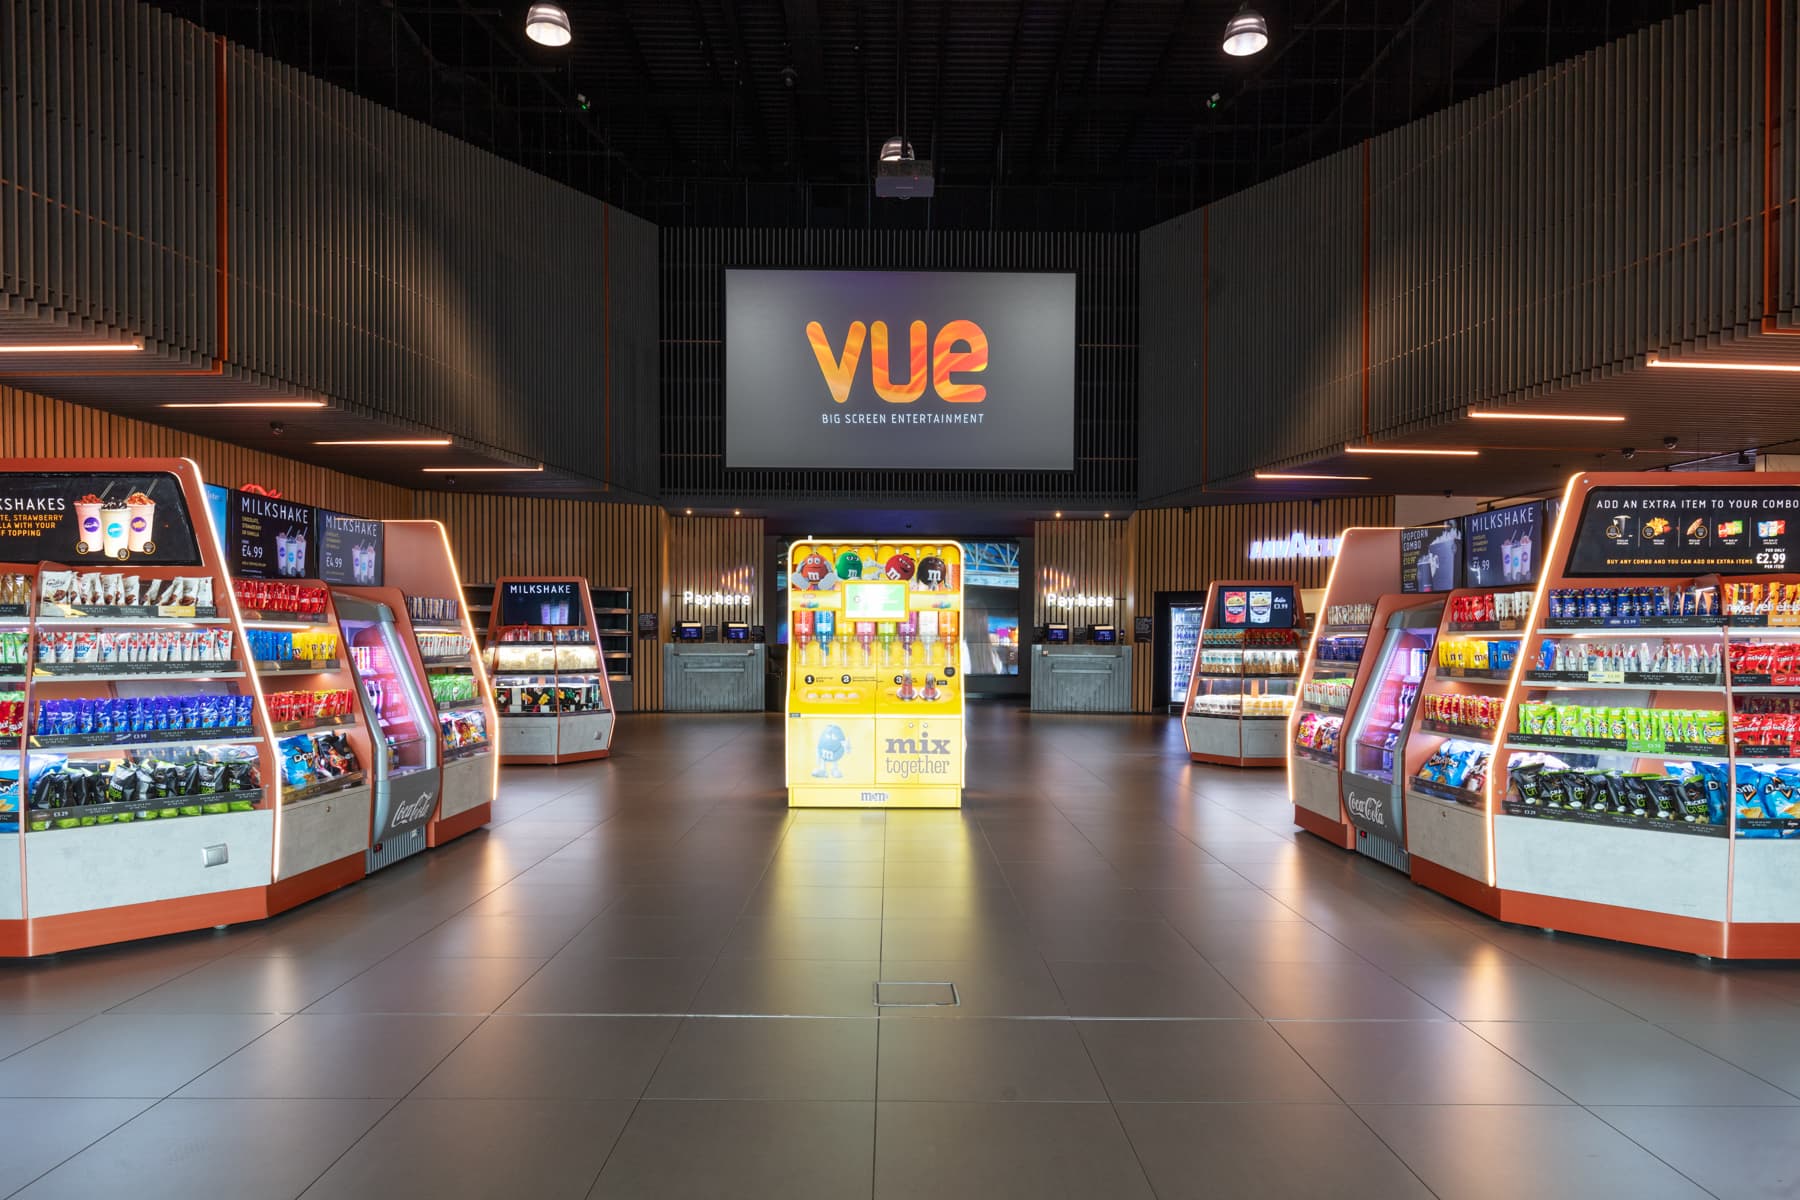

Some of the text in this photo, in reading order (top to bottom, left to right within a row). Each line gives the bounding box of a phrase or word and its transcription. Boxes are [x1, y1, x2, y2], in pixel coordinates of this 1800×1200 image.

[822, 413, 985, 424] BIG SCREEN ENTERTAINMENT
[241, 496, 309, 524] MILKSHAKE
[1596, 499, 1799, 509] ADD AN EXTRA ITEM TO YOUR COMBO
[325, 515, 377, 537] MILKSHAKE
[1471, 507, 1534, 532] MILKSHAKE
[8, 529, 41, 537] TOPPING
[1403, 529, 1429, 541] POPCORN
[241, 545, 263, 559] £4.99
[1756, 552, 1786, 564] £2.99
[326, 556, 343, 568] £4.99
[510, 584, 571, 594] MILKSHAKE
[684, 591, 751, 608] Pay here
[1047, 593, 1114, 610] Pay here
[885, 732, 951, 755] mix
[886, 755, 950, 779] together
